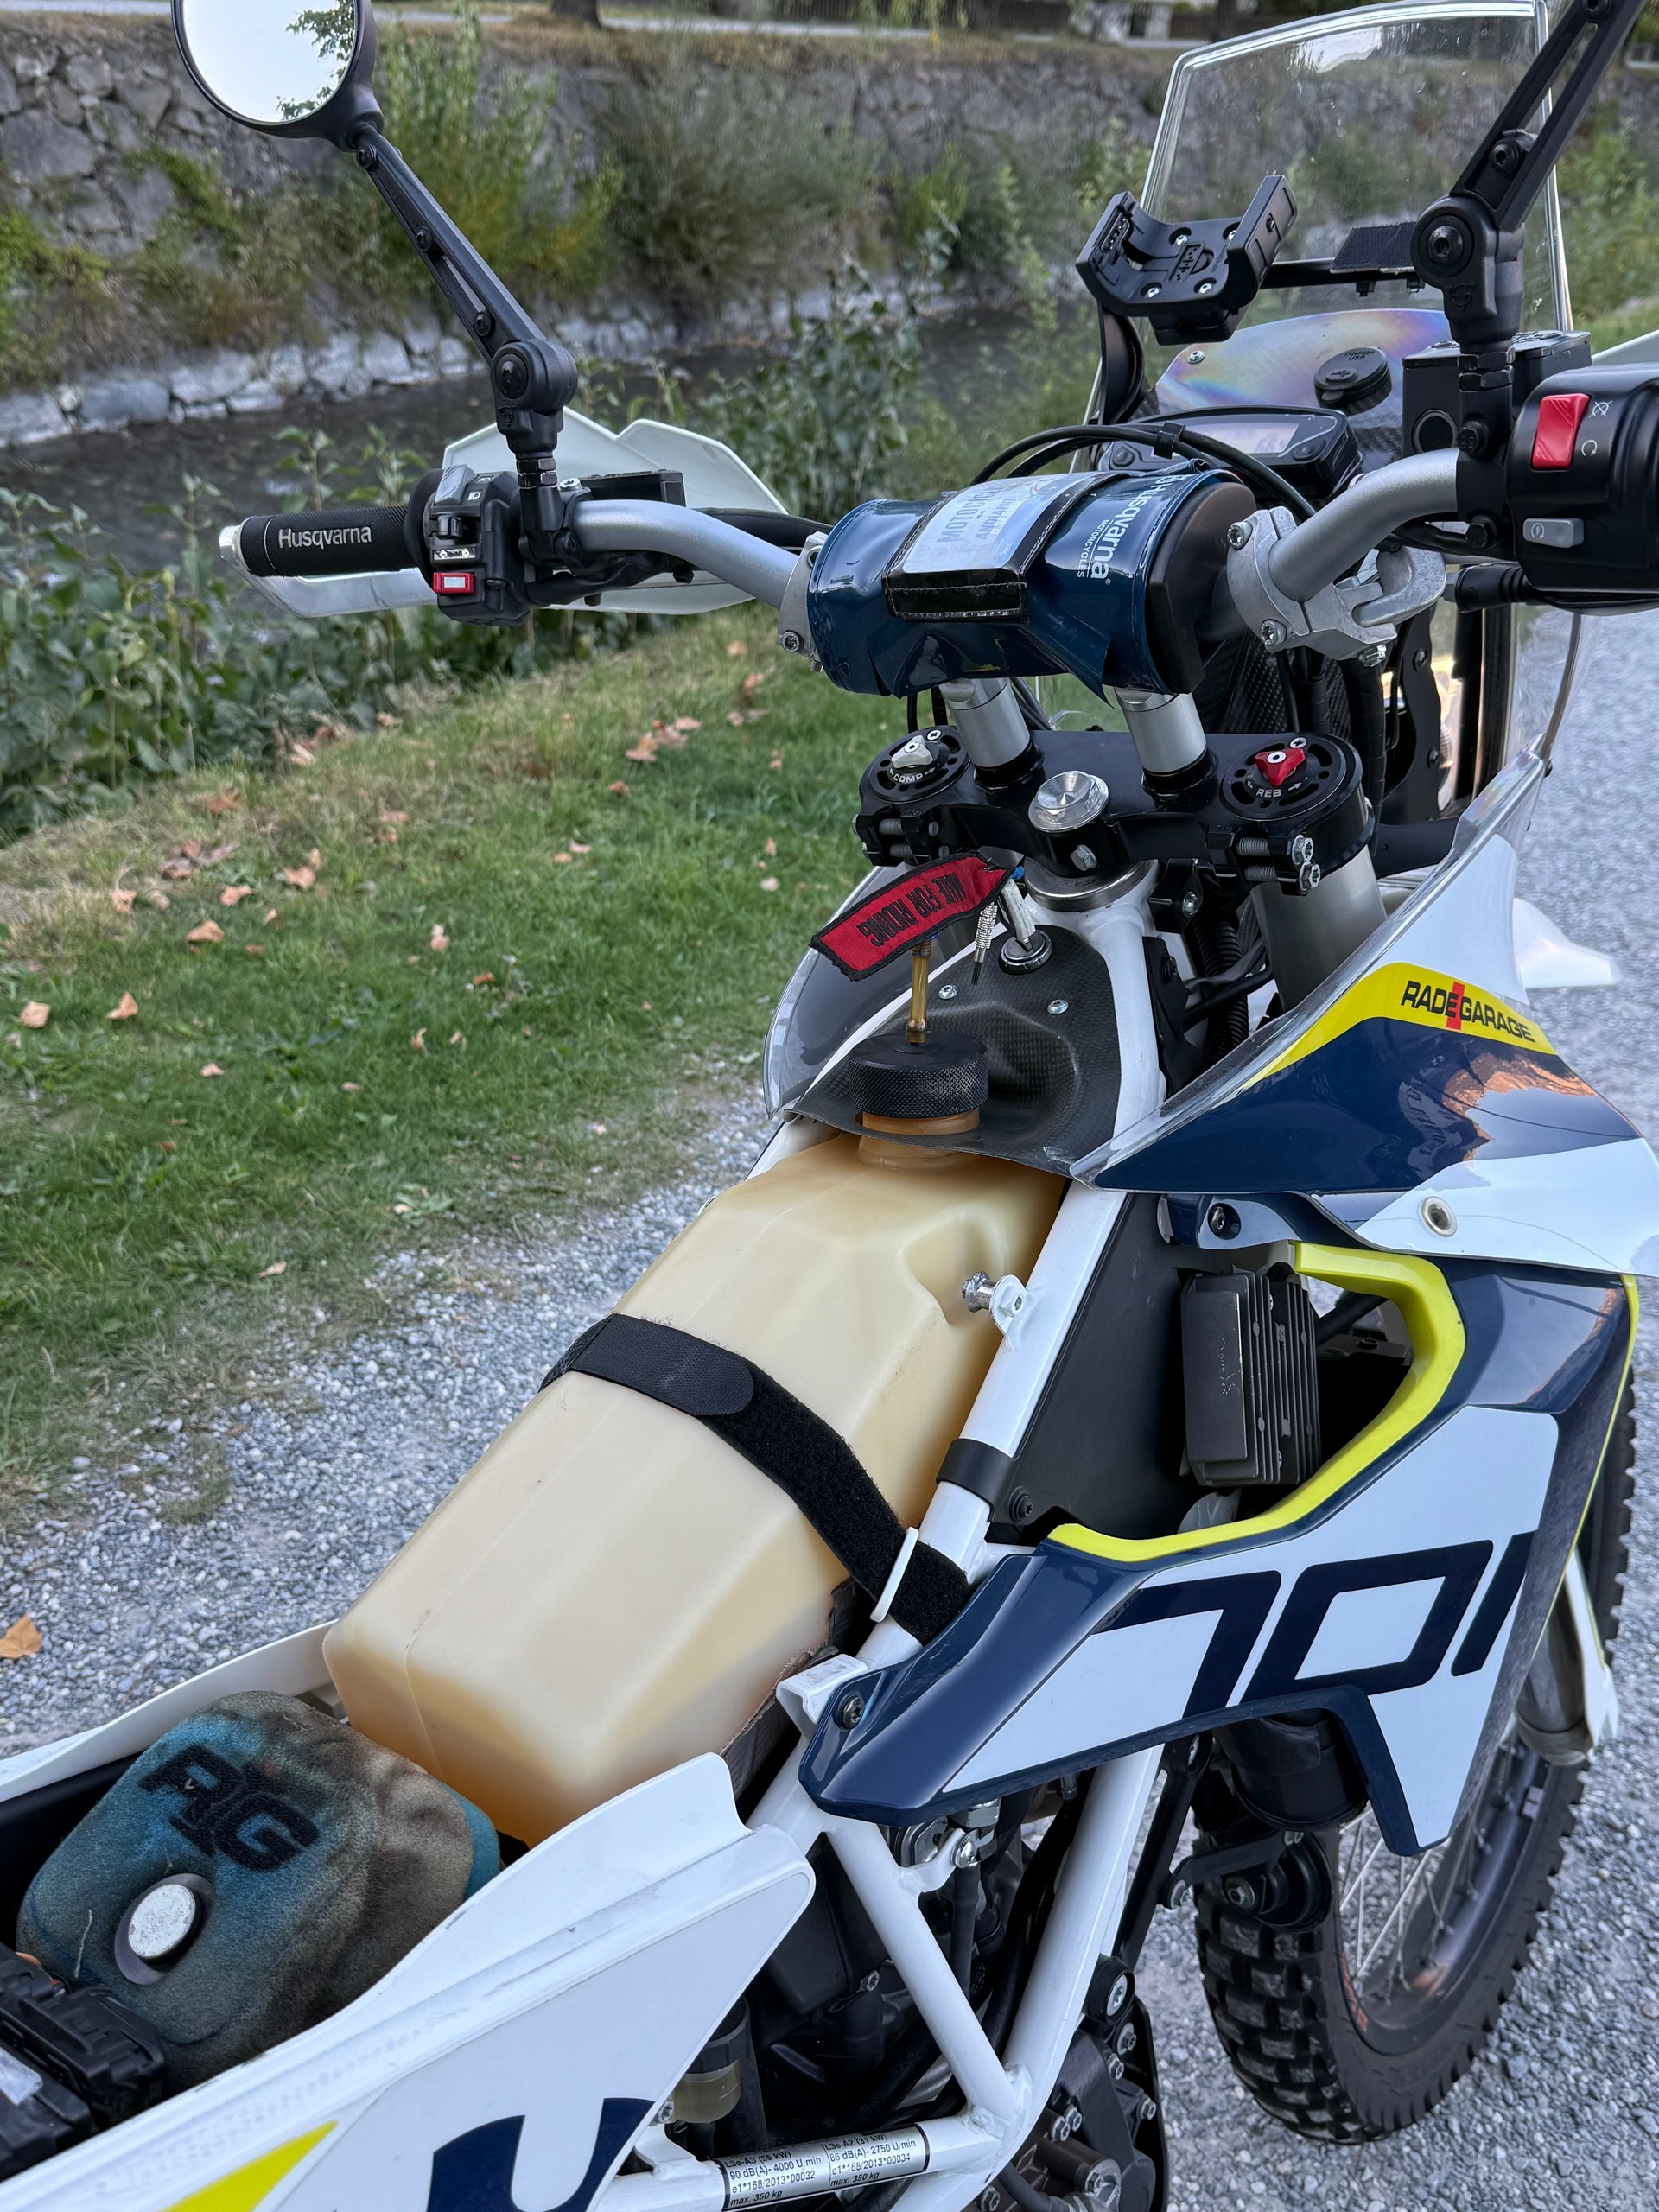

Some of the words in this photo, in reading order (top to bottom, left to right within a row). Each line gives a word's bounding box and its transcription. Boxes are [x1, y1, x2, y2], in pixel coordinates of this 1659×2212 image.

[278, 526, 372, 550] Husqvarna
[1091, 482, 1166, 579] Husqvarna
[1077, 519, 1110, 578] MOTORCYCLES
[893, 772, 924, 783] COMP
[1255, 788, 1281, 798] REB
[906, 884, 943, 918] FOR
[856, 899, 918, 947] RIDING
[830, 2152, 841, 2163] 86
[870, 2143, 891, 2155] 2750
[893, 2139, 917, 2152] U/min
[856, 2136, 869, 2146] (31
[870, 2133, 888, 2143] kW)
[729, 2170, 741, 2180] 90
[773, 2161, 795, 2172] 4000
[796, 2156, 822, 2171] U/min
[759, 2154, 772, 2164] (55
[773, 2151, 792, 2159] kW)
[830, 2176, 850, 2187] max.
[852, 2172, 868, 2183] 350
[869, 2171, 880, 2180] kg
[730, 2195, 751, 2206] max.
[753, 2192, 770, 2202] 350
[772, 2190, 783, 2199] kg
